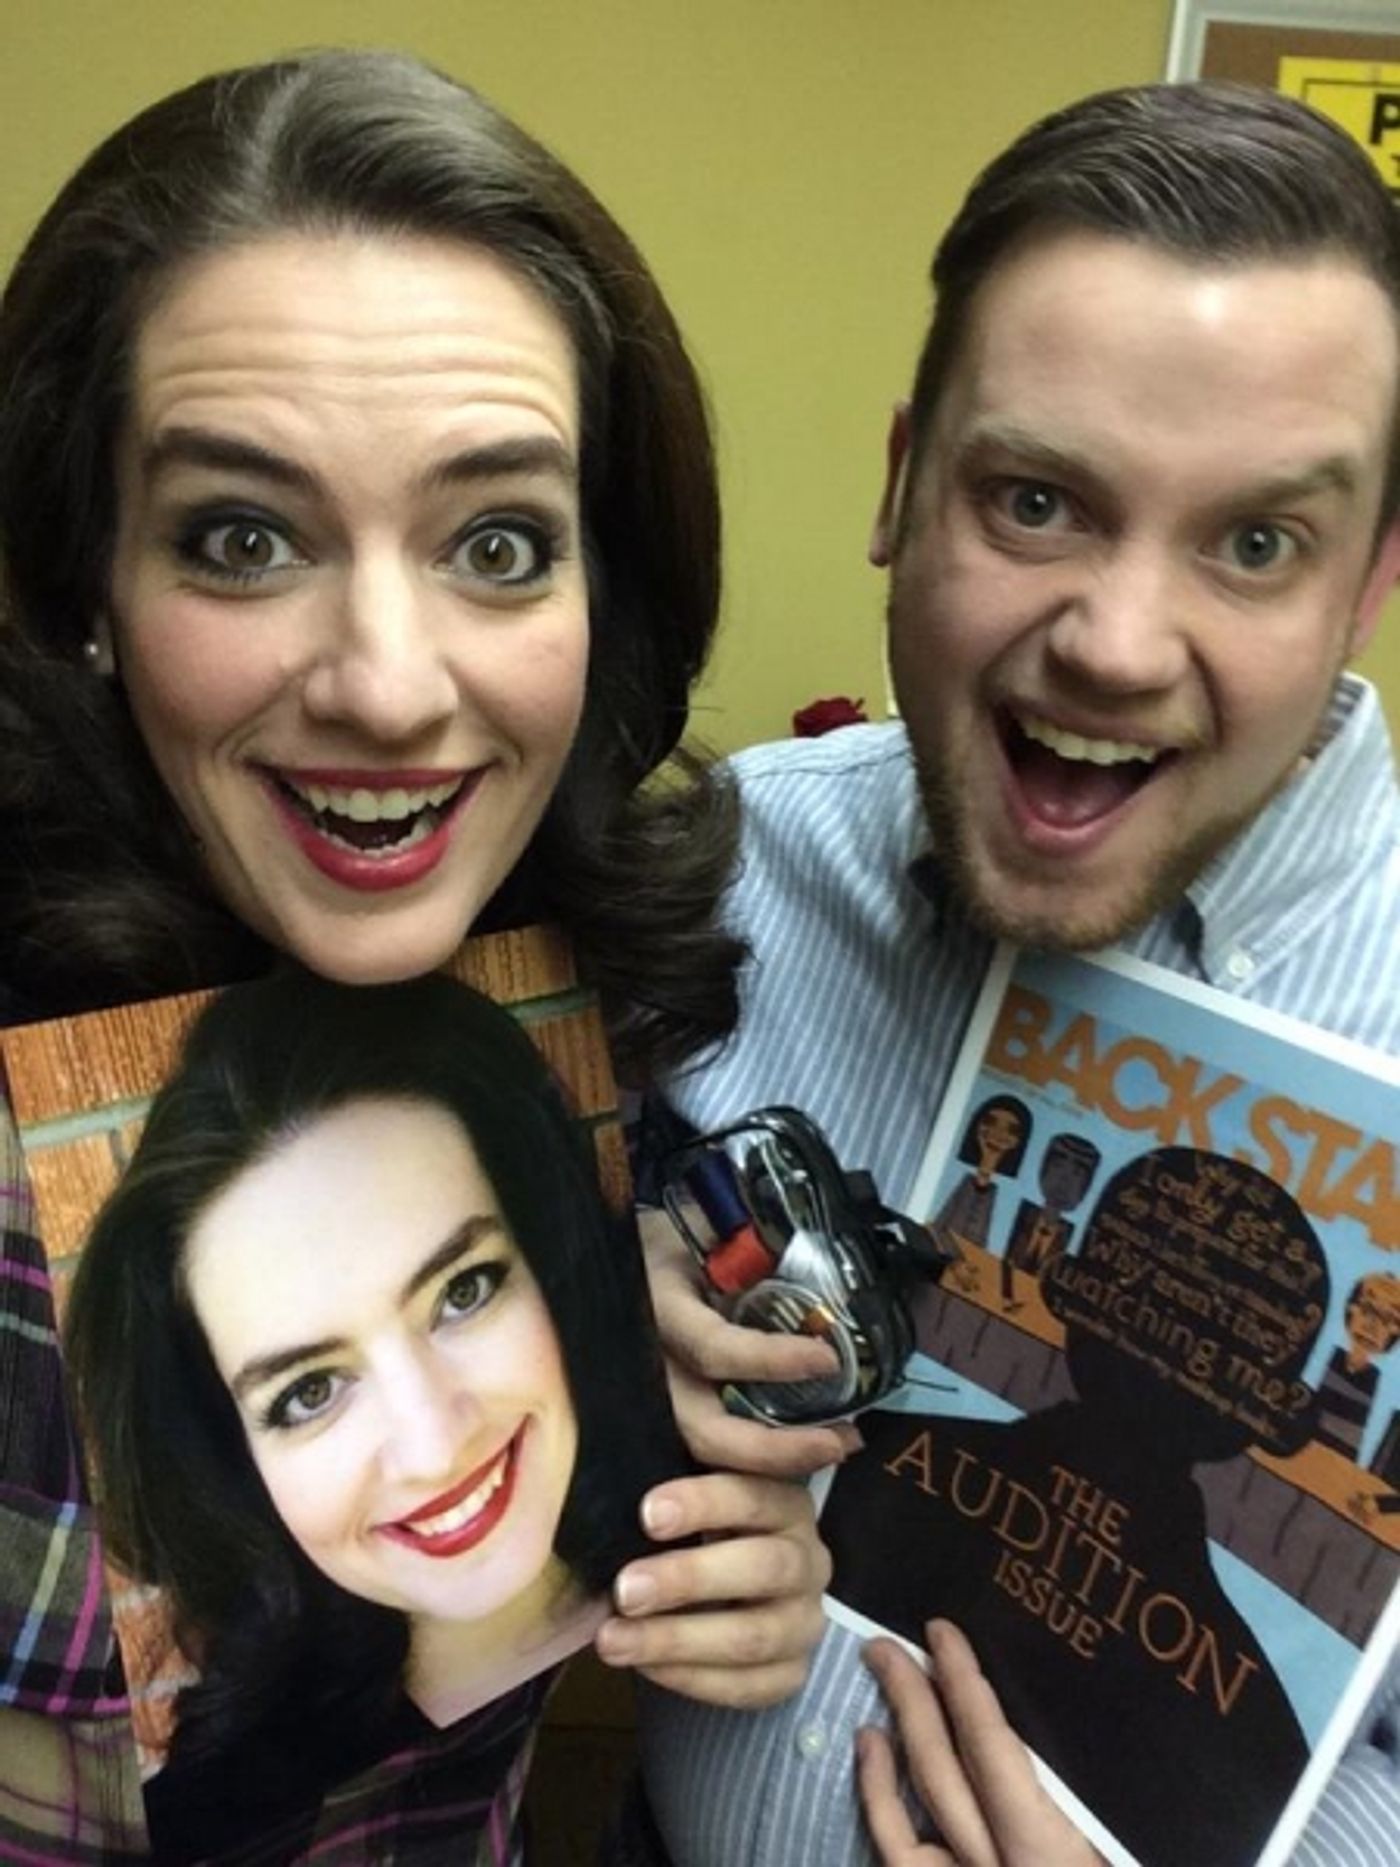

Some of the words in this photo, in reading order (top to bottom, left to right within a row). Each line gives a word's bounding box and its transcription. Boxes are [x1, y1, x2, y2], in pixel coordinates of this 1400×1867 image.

[984, 983, 1245, 1151] BACK
[1050, 1260, 1222, 1378] watching
[1050, 1464, 1131, 1545] THE
[883, 1430, 1259, 1717] AUDITION
[993, 1550, 1107, 1660] ISSUE
